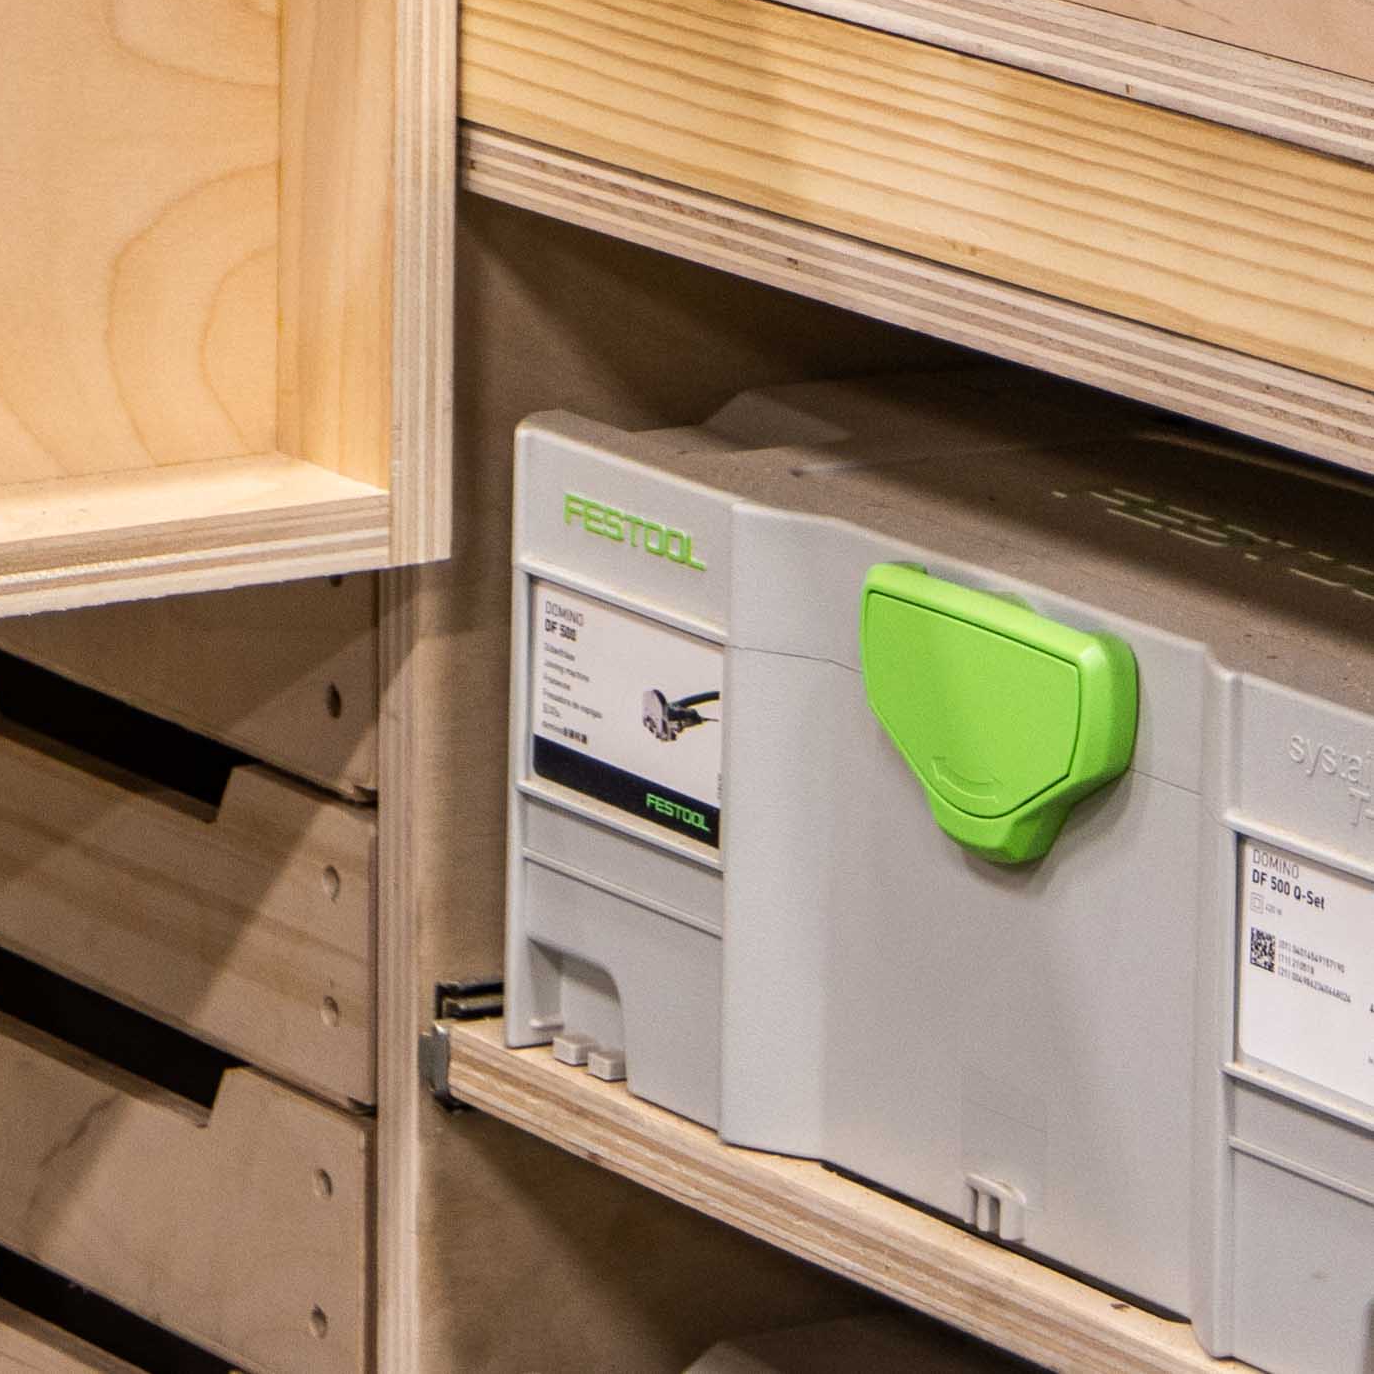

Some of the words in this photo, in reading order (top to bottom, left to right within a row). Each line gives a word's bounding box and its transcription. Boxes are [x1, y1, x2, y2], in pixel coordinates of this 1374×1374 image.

[562, 492, 708, 572] FESTOOL
[646, 792, 711, 841] FESTOOL
[1253, 848, 1299, 880] DOMINO
[1252, 868, 1267, 886] DF
[1271, 876, 1291, 896] 500
[1293, 885, 1325, 910] Q-Set
